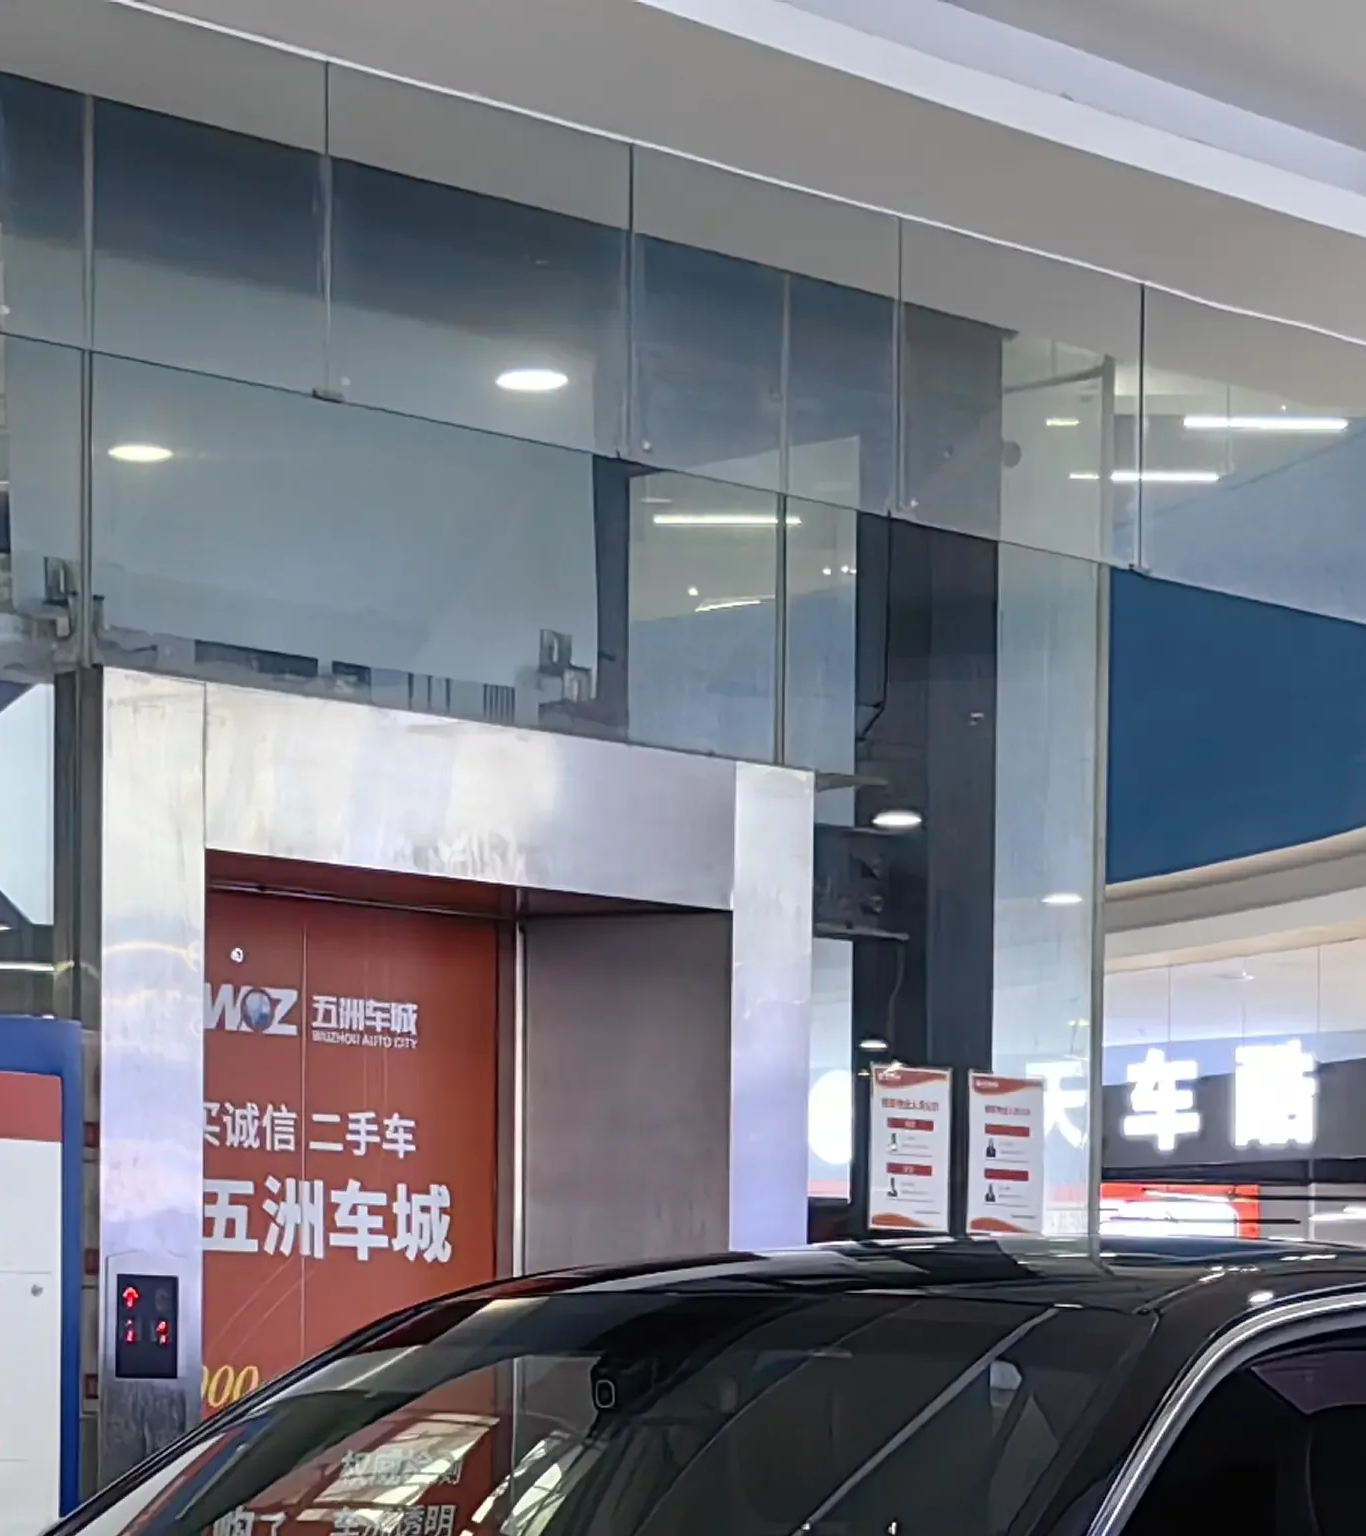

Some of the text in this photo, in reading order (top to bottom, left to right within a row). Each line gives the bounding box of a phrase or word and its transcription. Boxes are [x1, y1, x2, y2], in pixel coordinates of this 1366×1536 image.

[311, 994, 419, 1036] 五洲车城
[311, 1030, 360, 1046] WUZHOU
[308, 1112, 417, 1159] 二手车
[202, 1176, 452, 1264] 五洲车城
